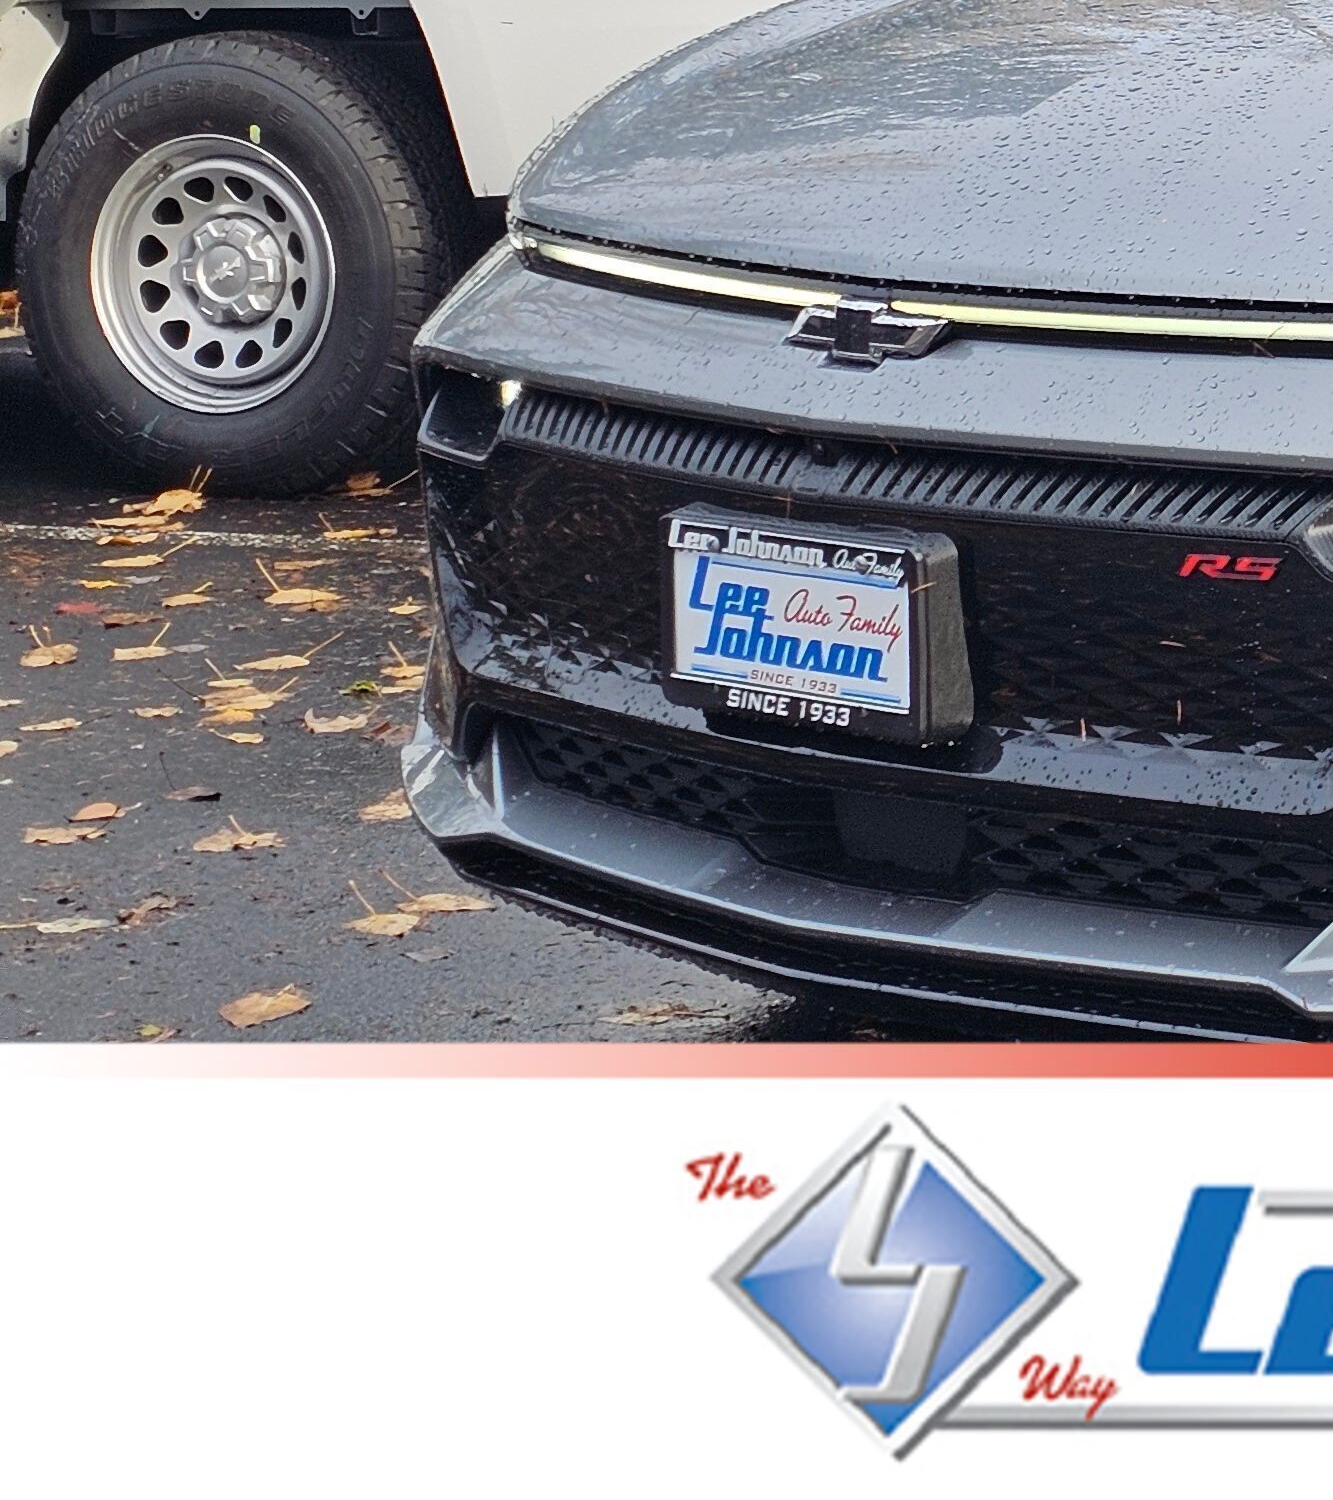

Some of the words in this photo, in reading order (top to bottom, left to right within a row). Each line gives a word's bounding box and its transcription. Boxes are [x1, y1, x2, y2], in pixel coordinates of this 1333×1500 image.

[689, 555, 775, 621] Lee
[1178, 553, 1284, 581] RS
[693, 608, 888, 683] Johnson
[784, 588, 833, 628] Auto
[836, 594, 903, 654] Family
[726, 688, 790, 717] SINCE
[798, 700, 851, 728] 1933
[750, 668, 794, 688] SINCE
[800, 677, 838, 695] 1933
